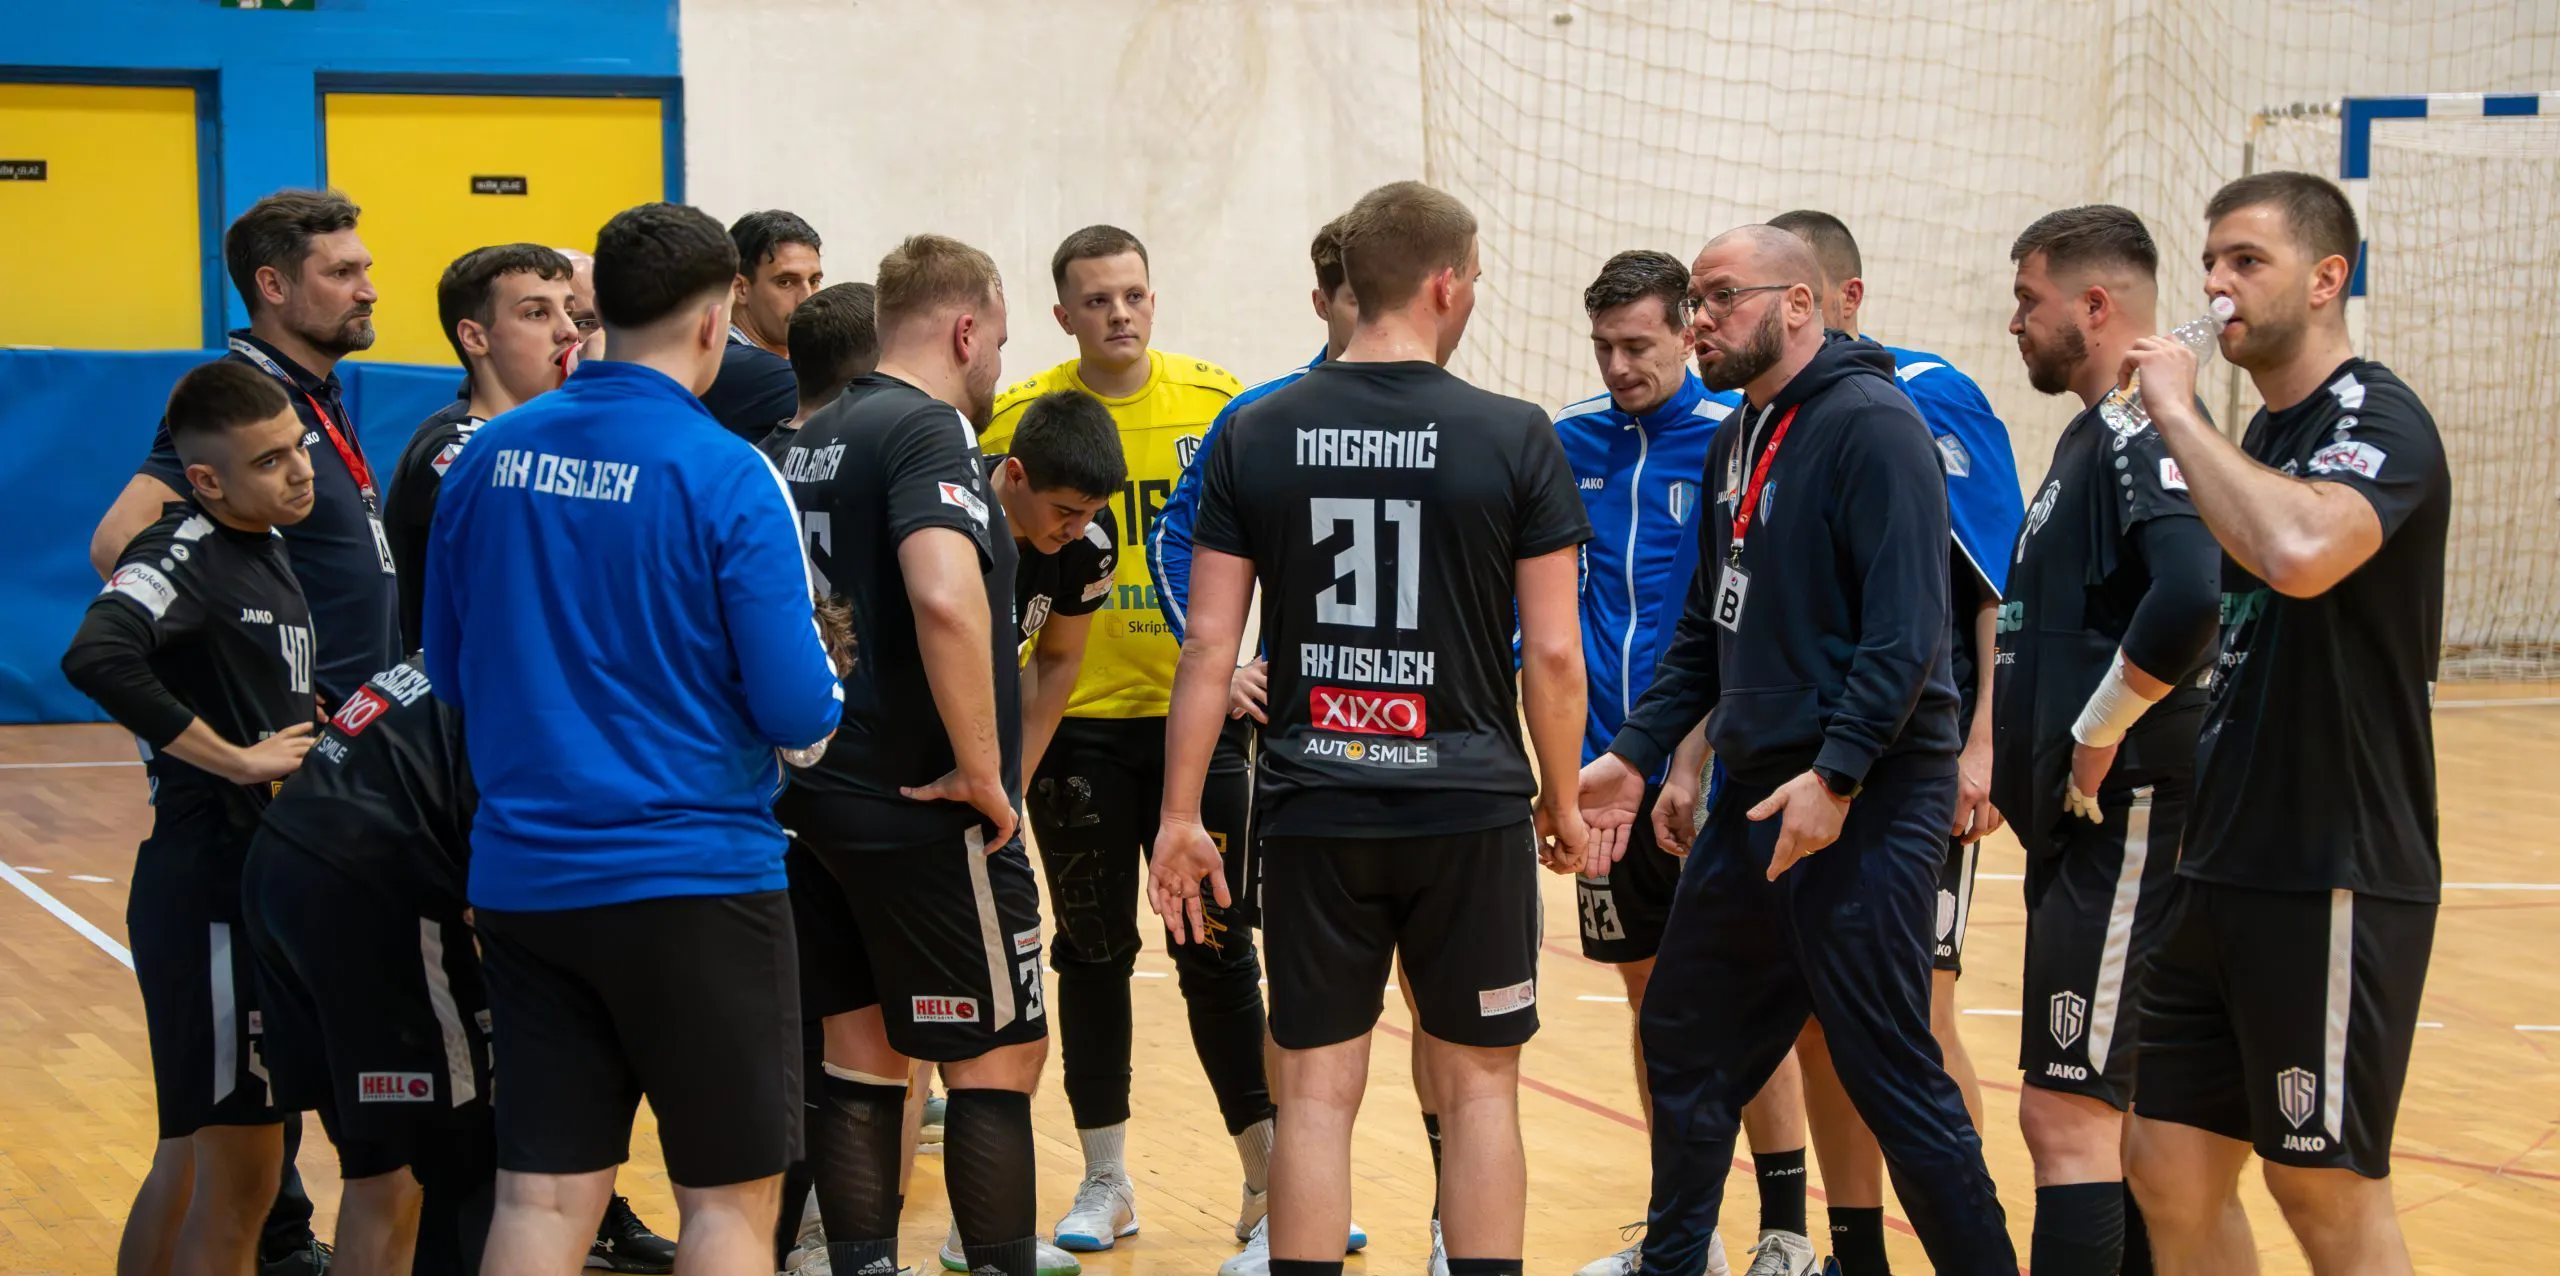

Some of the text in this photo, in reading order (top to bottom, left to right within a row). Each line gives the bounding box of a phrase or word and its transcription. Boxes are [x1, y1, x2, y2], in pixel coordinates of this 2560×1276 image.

[1296, 422, 1438, 468] MAGANIĆ
[492, 449, 639, 503] RK OSIJEK
[1580, 477, 1604, 490] JAKO
[380, 538, 394, 569] A
[1310, 497, 1421, 630] 31
[240, 608, 274, 625] JAKO
[1720, 587, 1739, 624] B
[278, 624, 310, 695] 40
[1301, 643, 1435, 685] RK OSIJEK
[335, 691, 381, 730] IXO
[1320, 692, 1418, 732] XIXO
[317, 736, 348, 764] SMILE
[1369, 744, 1428, 763] SMILE
[1579, 885, 1626, 941] 33
[1019, 957, 1044, 1022] 3
[915, 999, 954, 1015] HELL
[362, 1075, 405, 1094] HELL
[2045, 1062, 2088, 1081] JAKO
[2282, 1134, 2327, 1152] JAKO
[1765, 1166, 1804, 1177] JAKO
